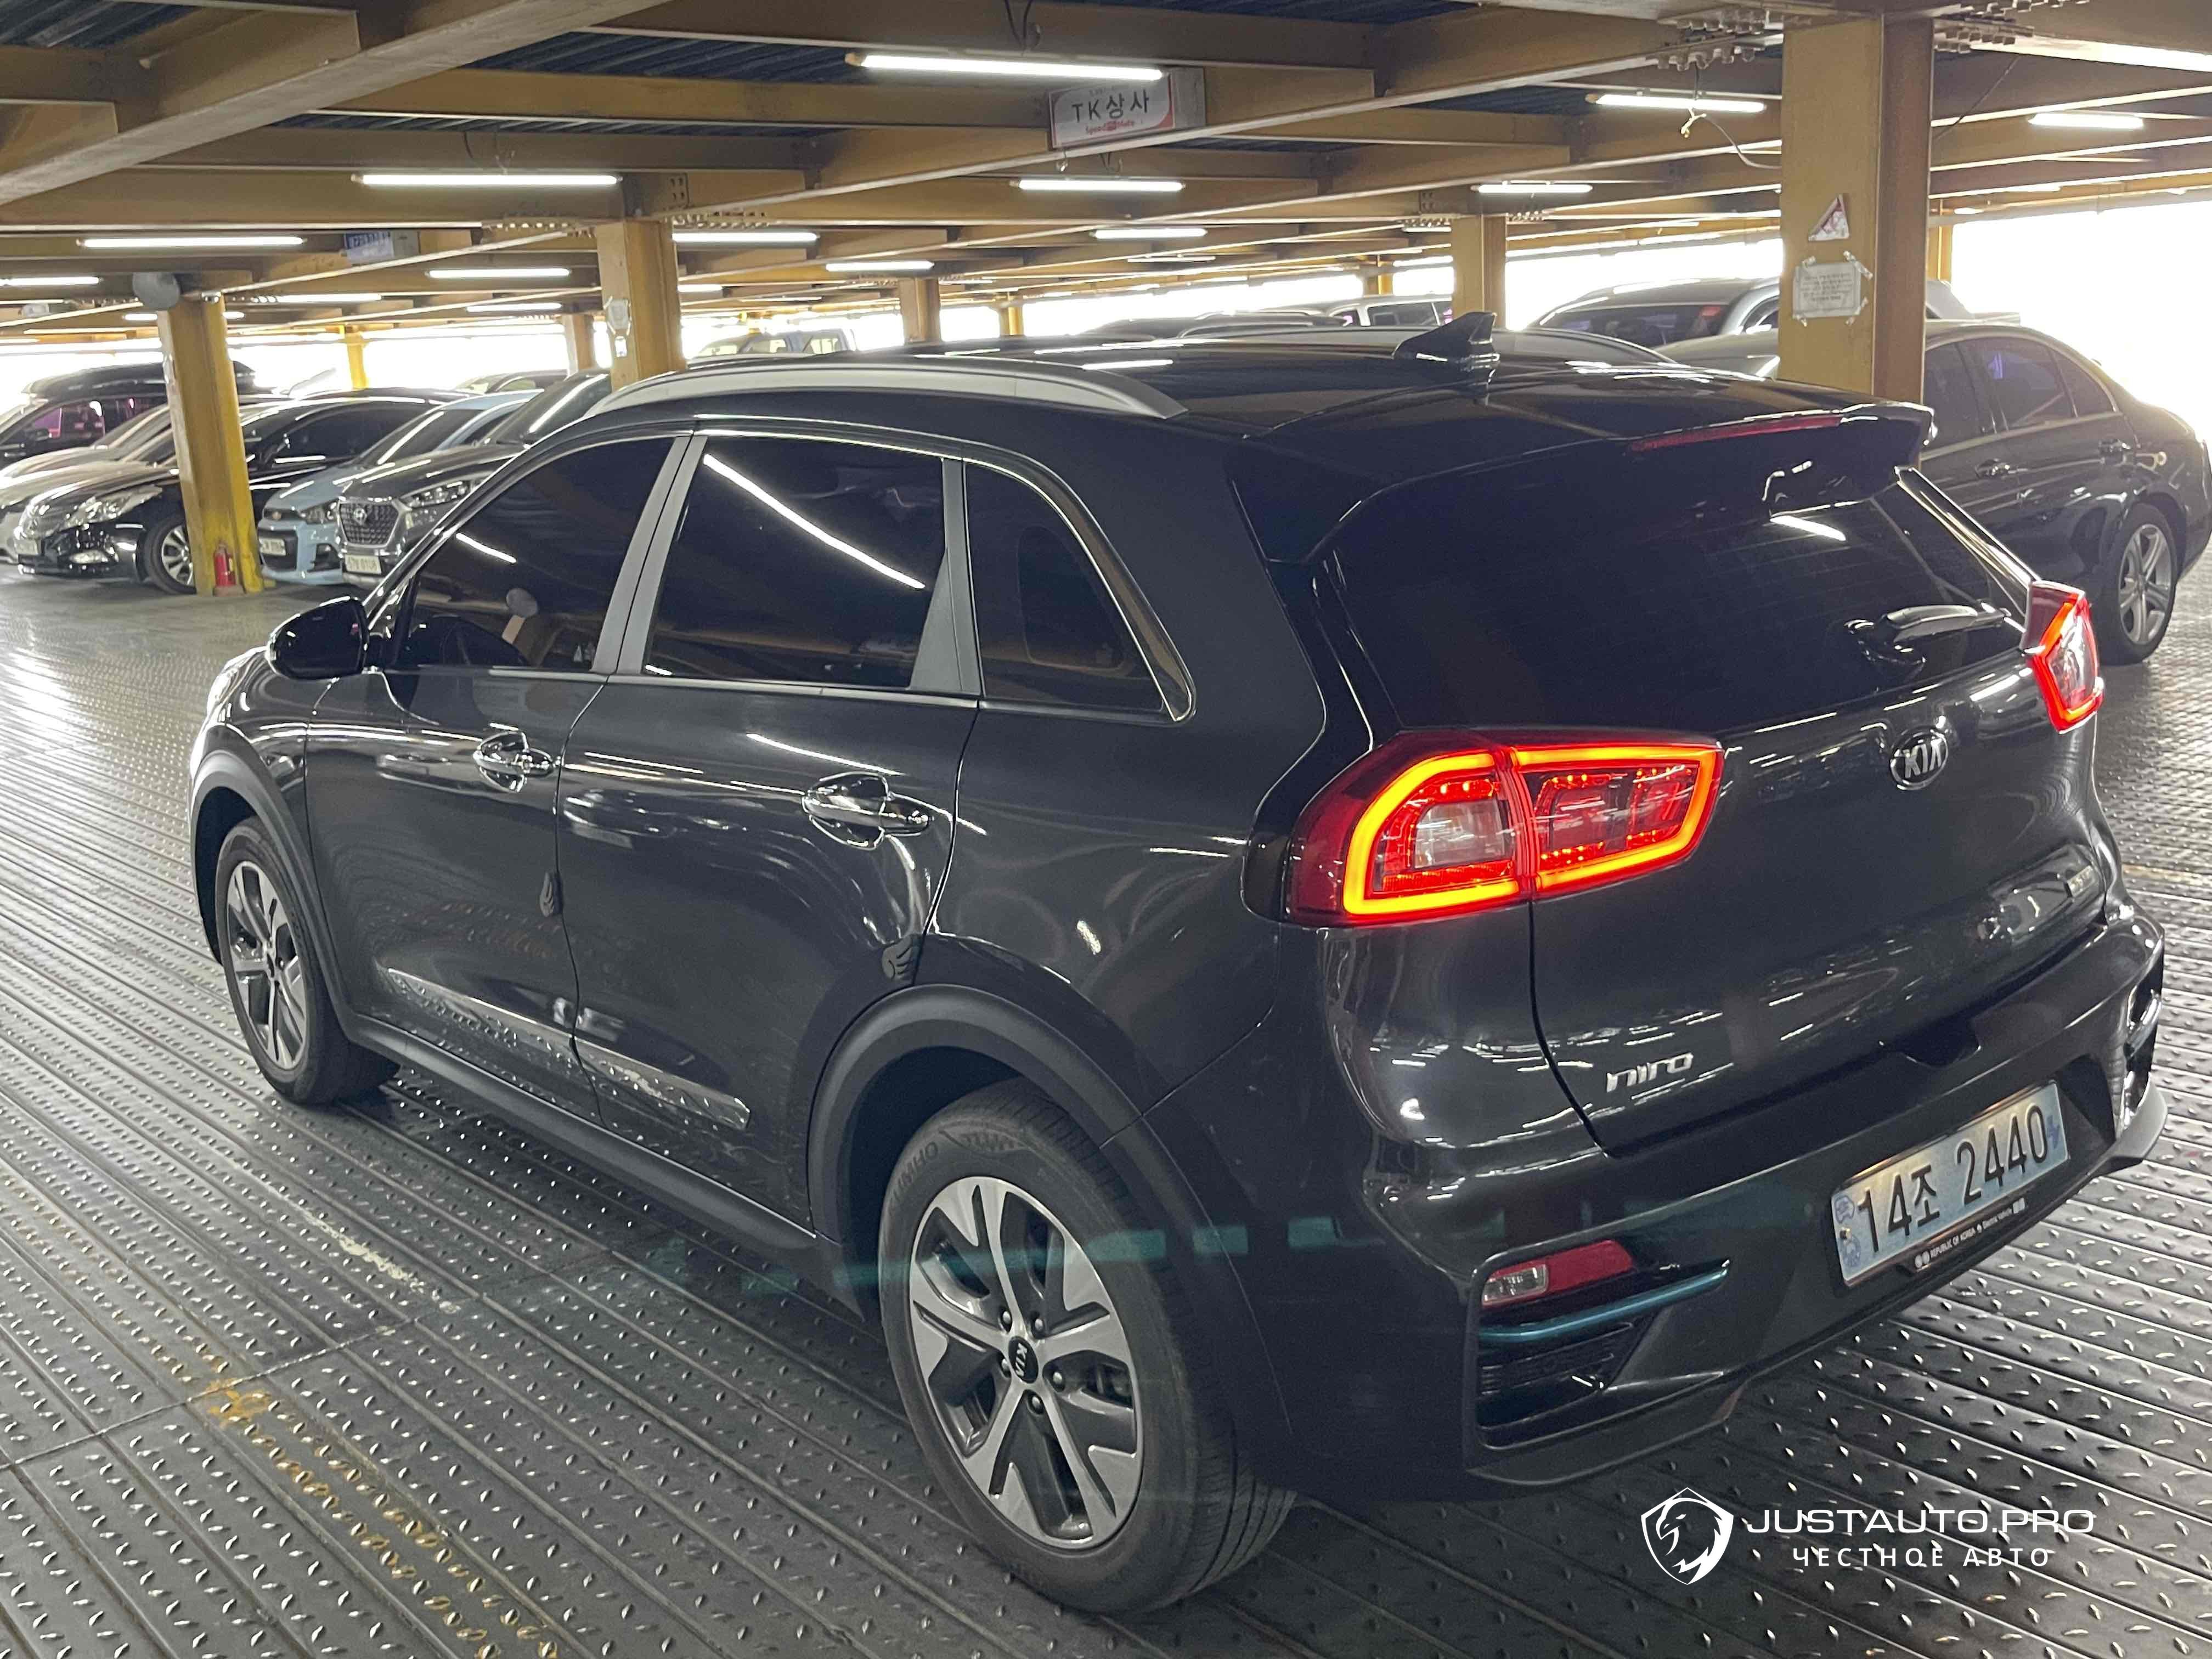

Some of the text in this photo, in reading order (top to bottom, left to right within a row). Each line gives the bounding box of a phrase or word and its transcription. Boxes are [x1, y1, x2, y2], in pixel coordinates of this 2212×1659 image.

[1072, 89, 1149, 122] TK상사
[1903, 737, 1943, 778] KIA
[1606, 1052, 1694, 1092] niro
[1857, 1104, 2048, 1253] 14조 2440
[1015, 1342, 1028, 1377] KIA
